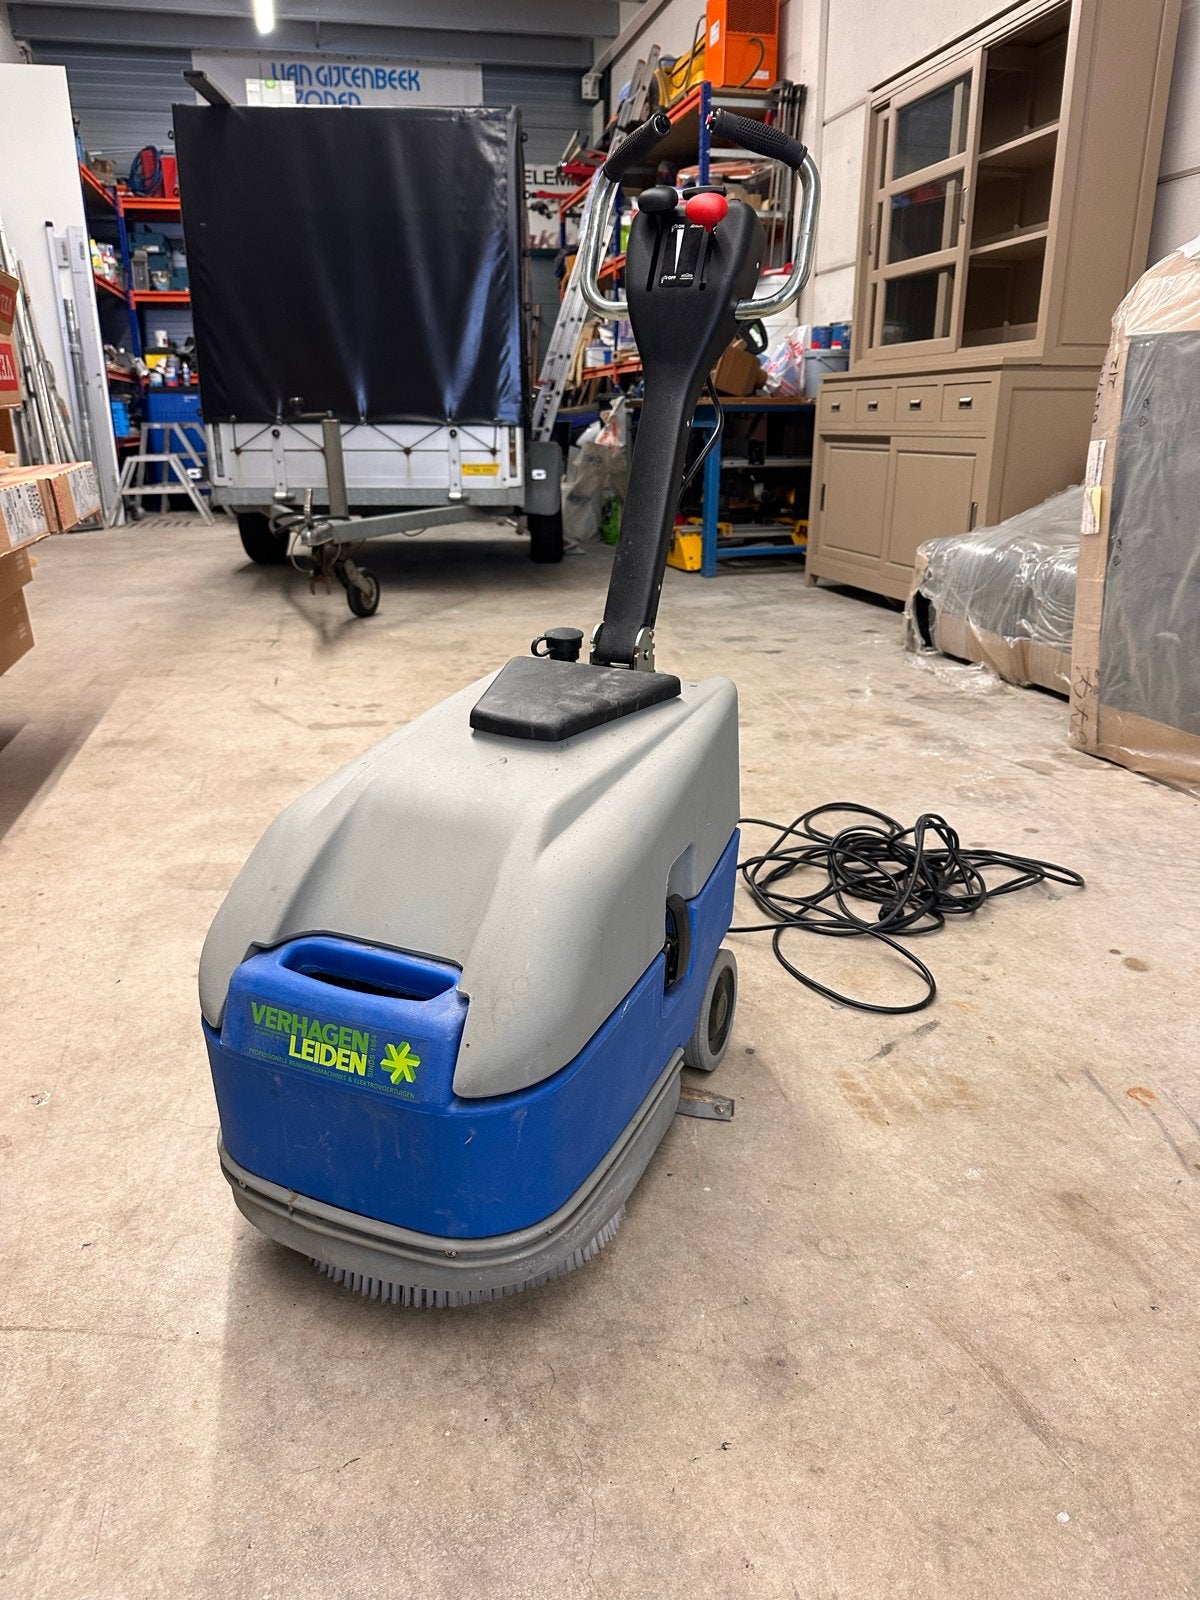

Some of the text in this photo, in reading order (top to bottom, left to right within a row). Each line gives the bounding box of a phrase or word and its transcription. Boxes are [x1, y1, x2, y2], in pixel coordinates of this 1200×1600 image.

[251, 1001, 370, 1054] VERHAGEN
[288, 1034, 368, 1077] LEIDEN
[367, 1054, 376, 1078] SINDS
[353, 1077, 415, 1099] ELEKTROVOERTUIGEN
